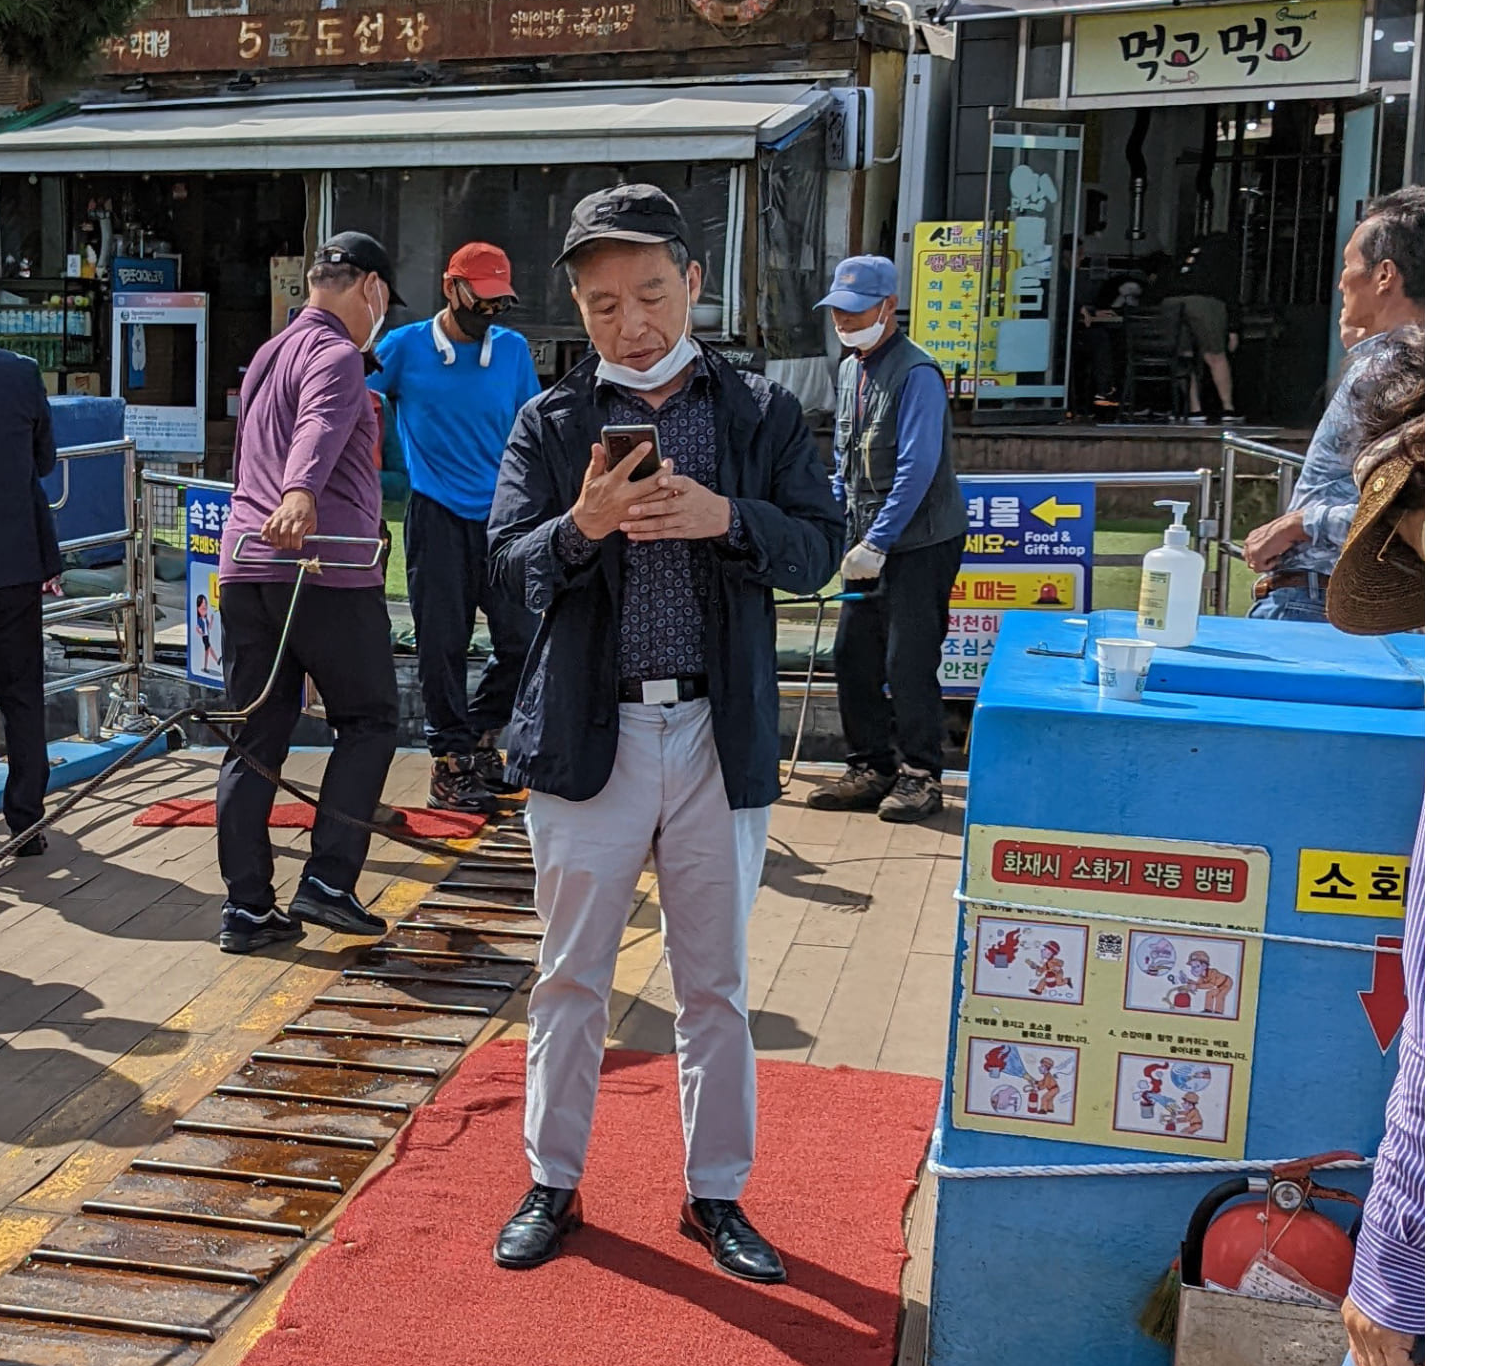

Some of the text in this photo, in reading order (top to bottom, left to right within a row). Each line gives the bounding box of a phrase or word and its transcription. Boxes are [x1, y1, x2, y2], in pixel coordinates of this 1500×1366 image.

[1119, 15, 1311, 81] 먹고 먹고
[1025, 532, 1071, 542] Food &
[1025, 544, 1085, 556] Gift shop
[974, 581, 1016, 601] 때는
[1003, 851, 1235, 893] 화재시 소화기 작동 방법
